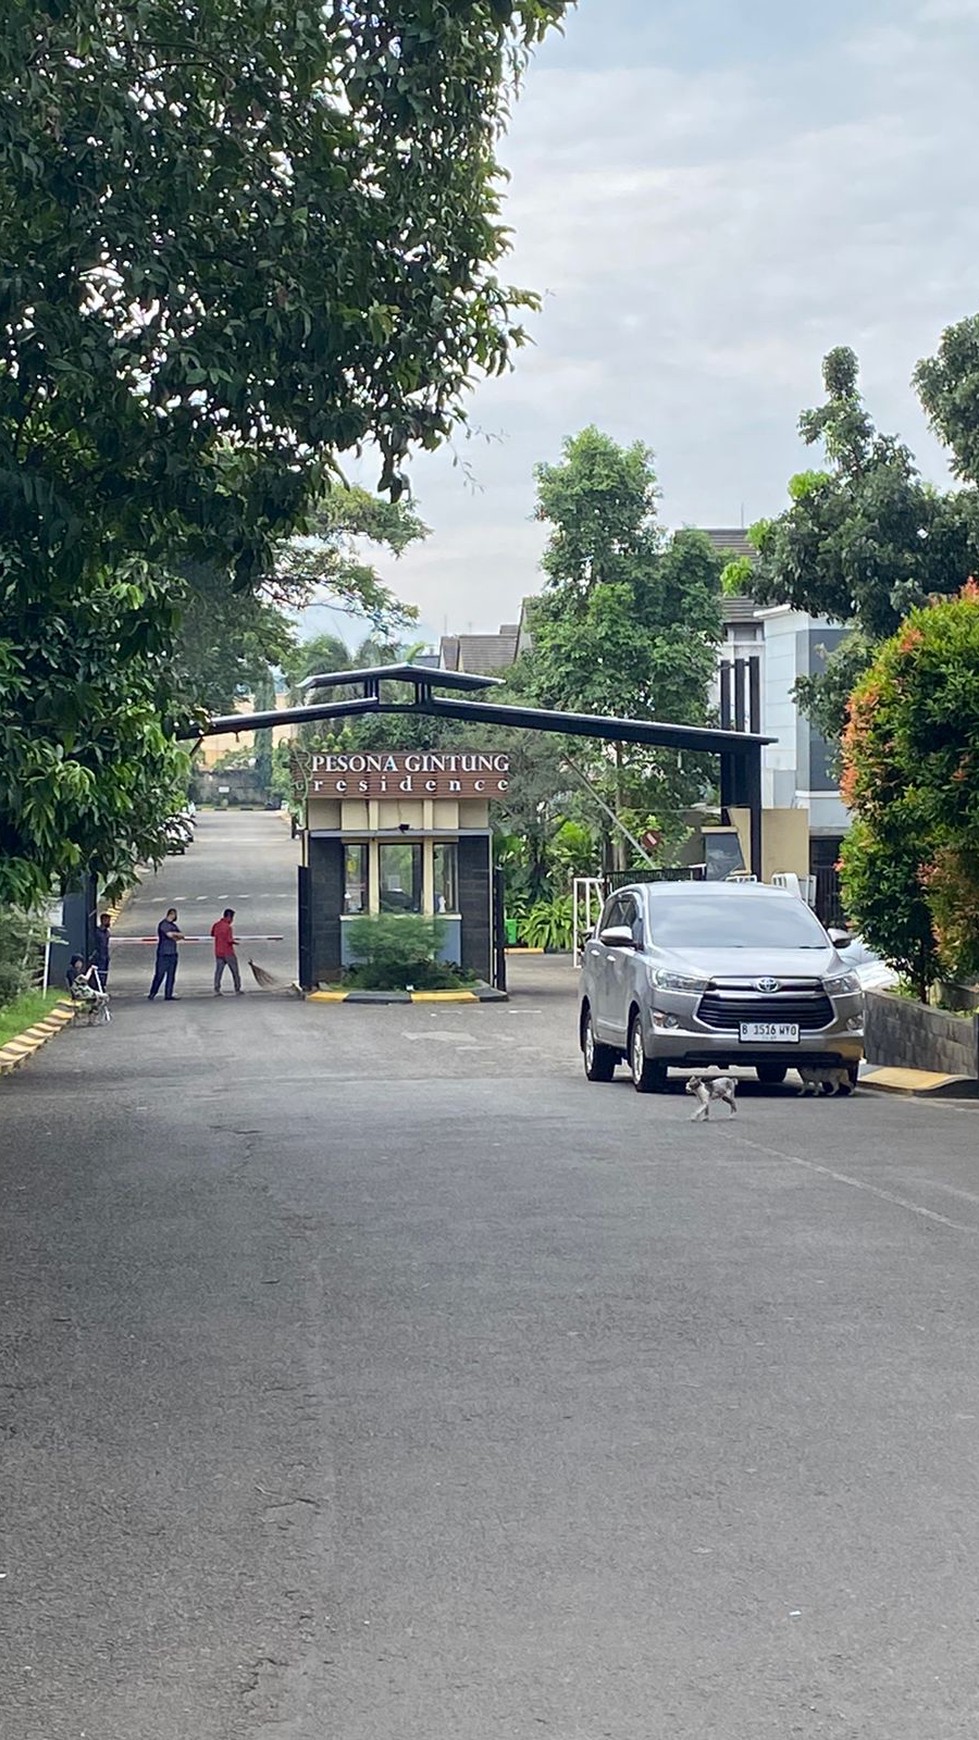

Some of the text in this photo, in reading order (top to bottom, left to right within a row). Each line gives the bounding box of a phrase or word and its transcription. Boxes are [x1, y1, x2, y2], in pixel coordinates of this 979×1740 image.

[312, 755, 509, 772] PESONA GINTUNG
[314, 776, 509, 791] residence
[742, 1025, 748, 1035] B
[753, 1025, 776, 1035] 1516
